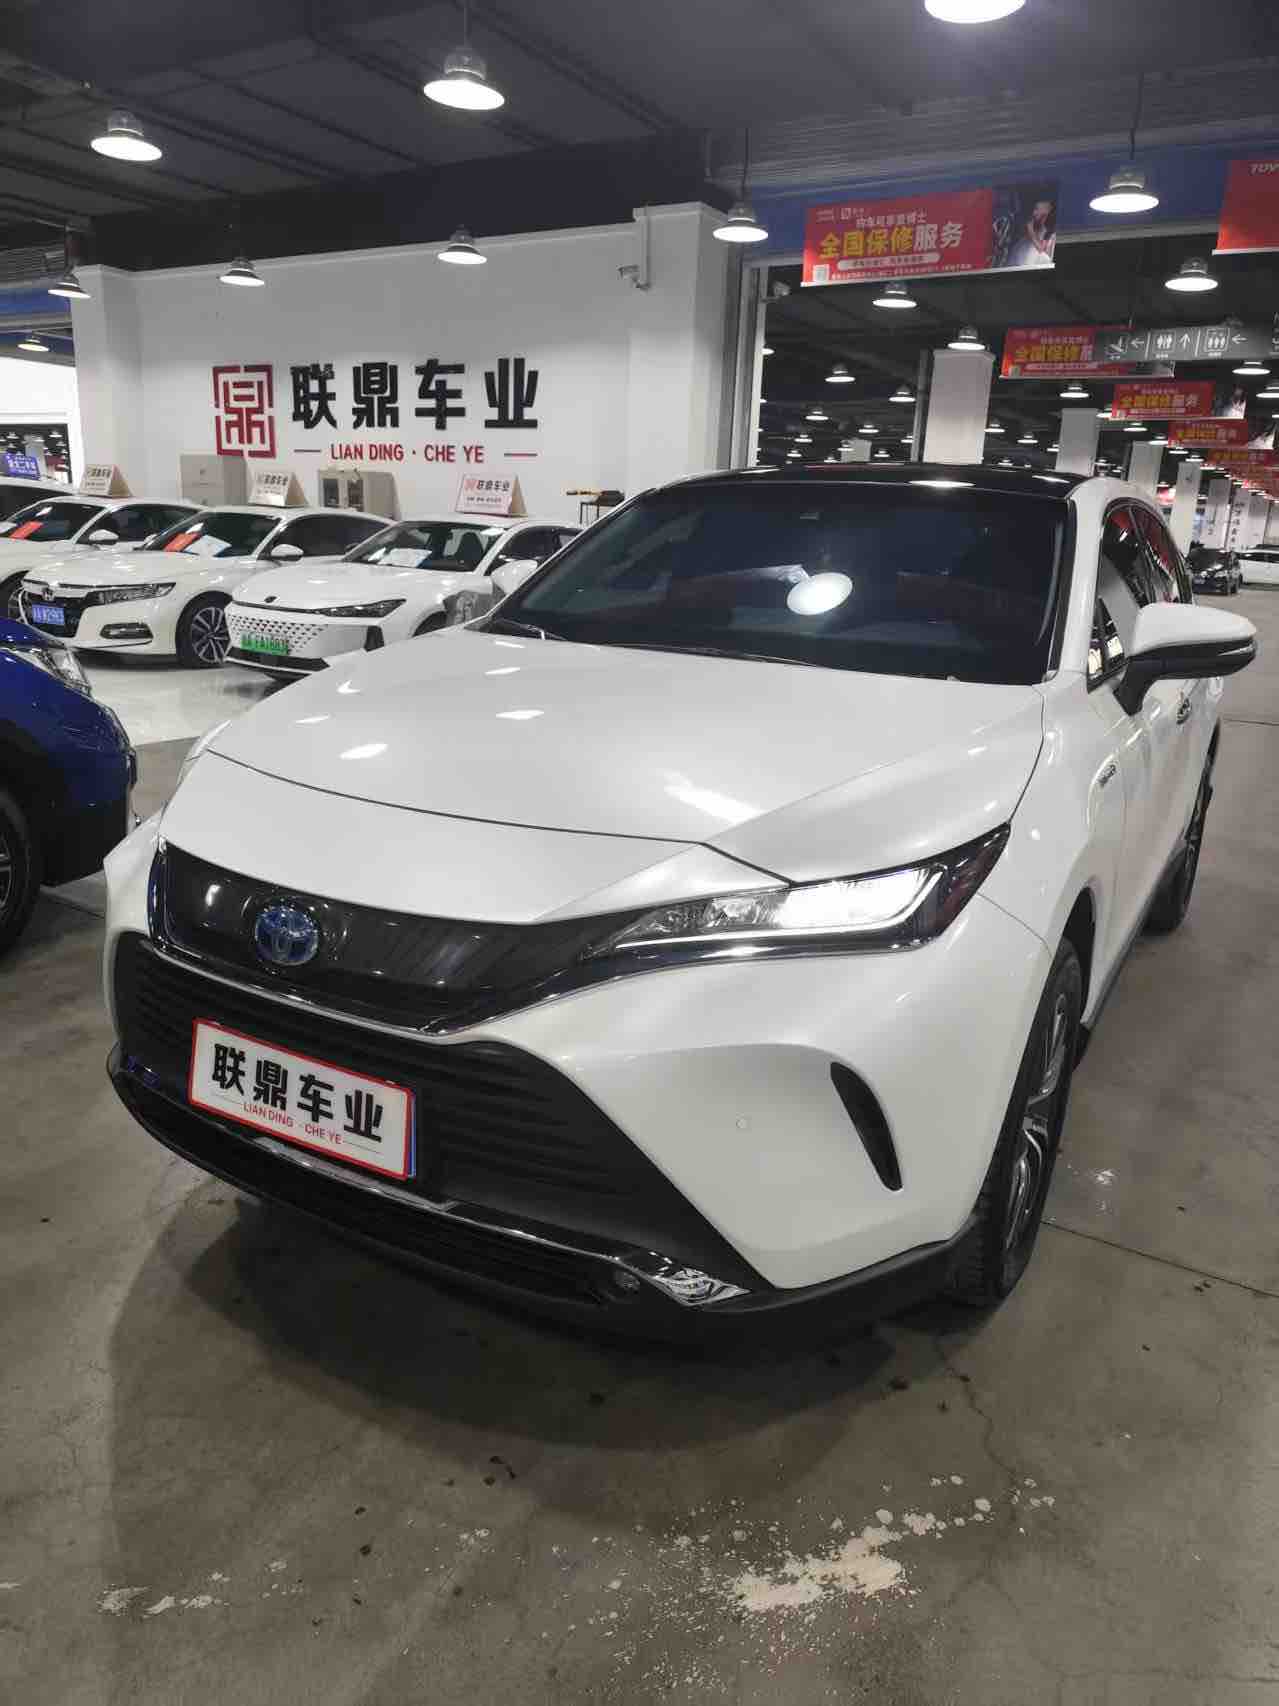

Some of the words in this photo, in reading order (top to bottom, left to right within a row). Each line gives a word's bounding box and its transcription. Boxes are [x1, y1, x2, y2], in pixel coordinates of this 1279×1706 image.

[819, 221, 964, 260] 全国保修服务
[290, 357, 539, 430] 联鼎车业
[331, 443, 364, 461] LIAN
[368, 444, 404, 462] DING
[424, 444, 456, 463] CHE
[462, 445, 485, 464] YE
[211, 1043, 384, 1143] 联鼎车业
[304, 1124, 326, 1139] CHE
[328, 1130, 343, 1145] YE
